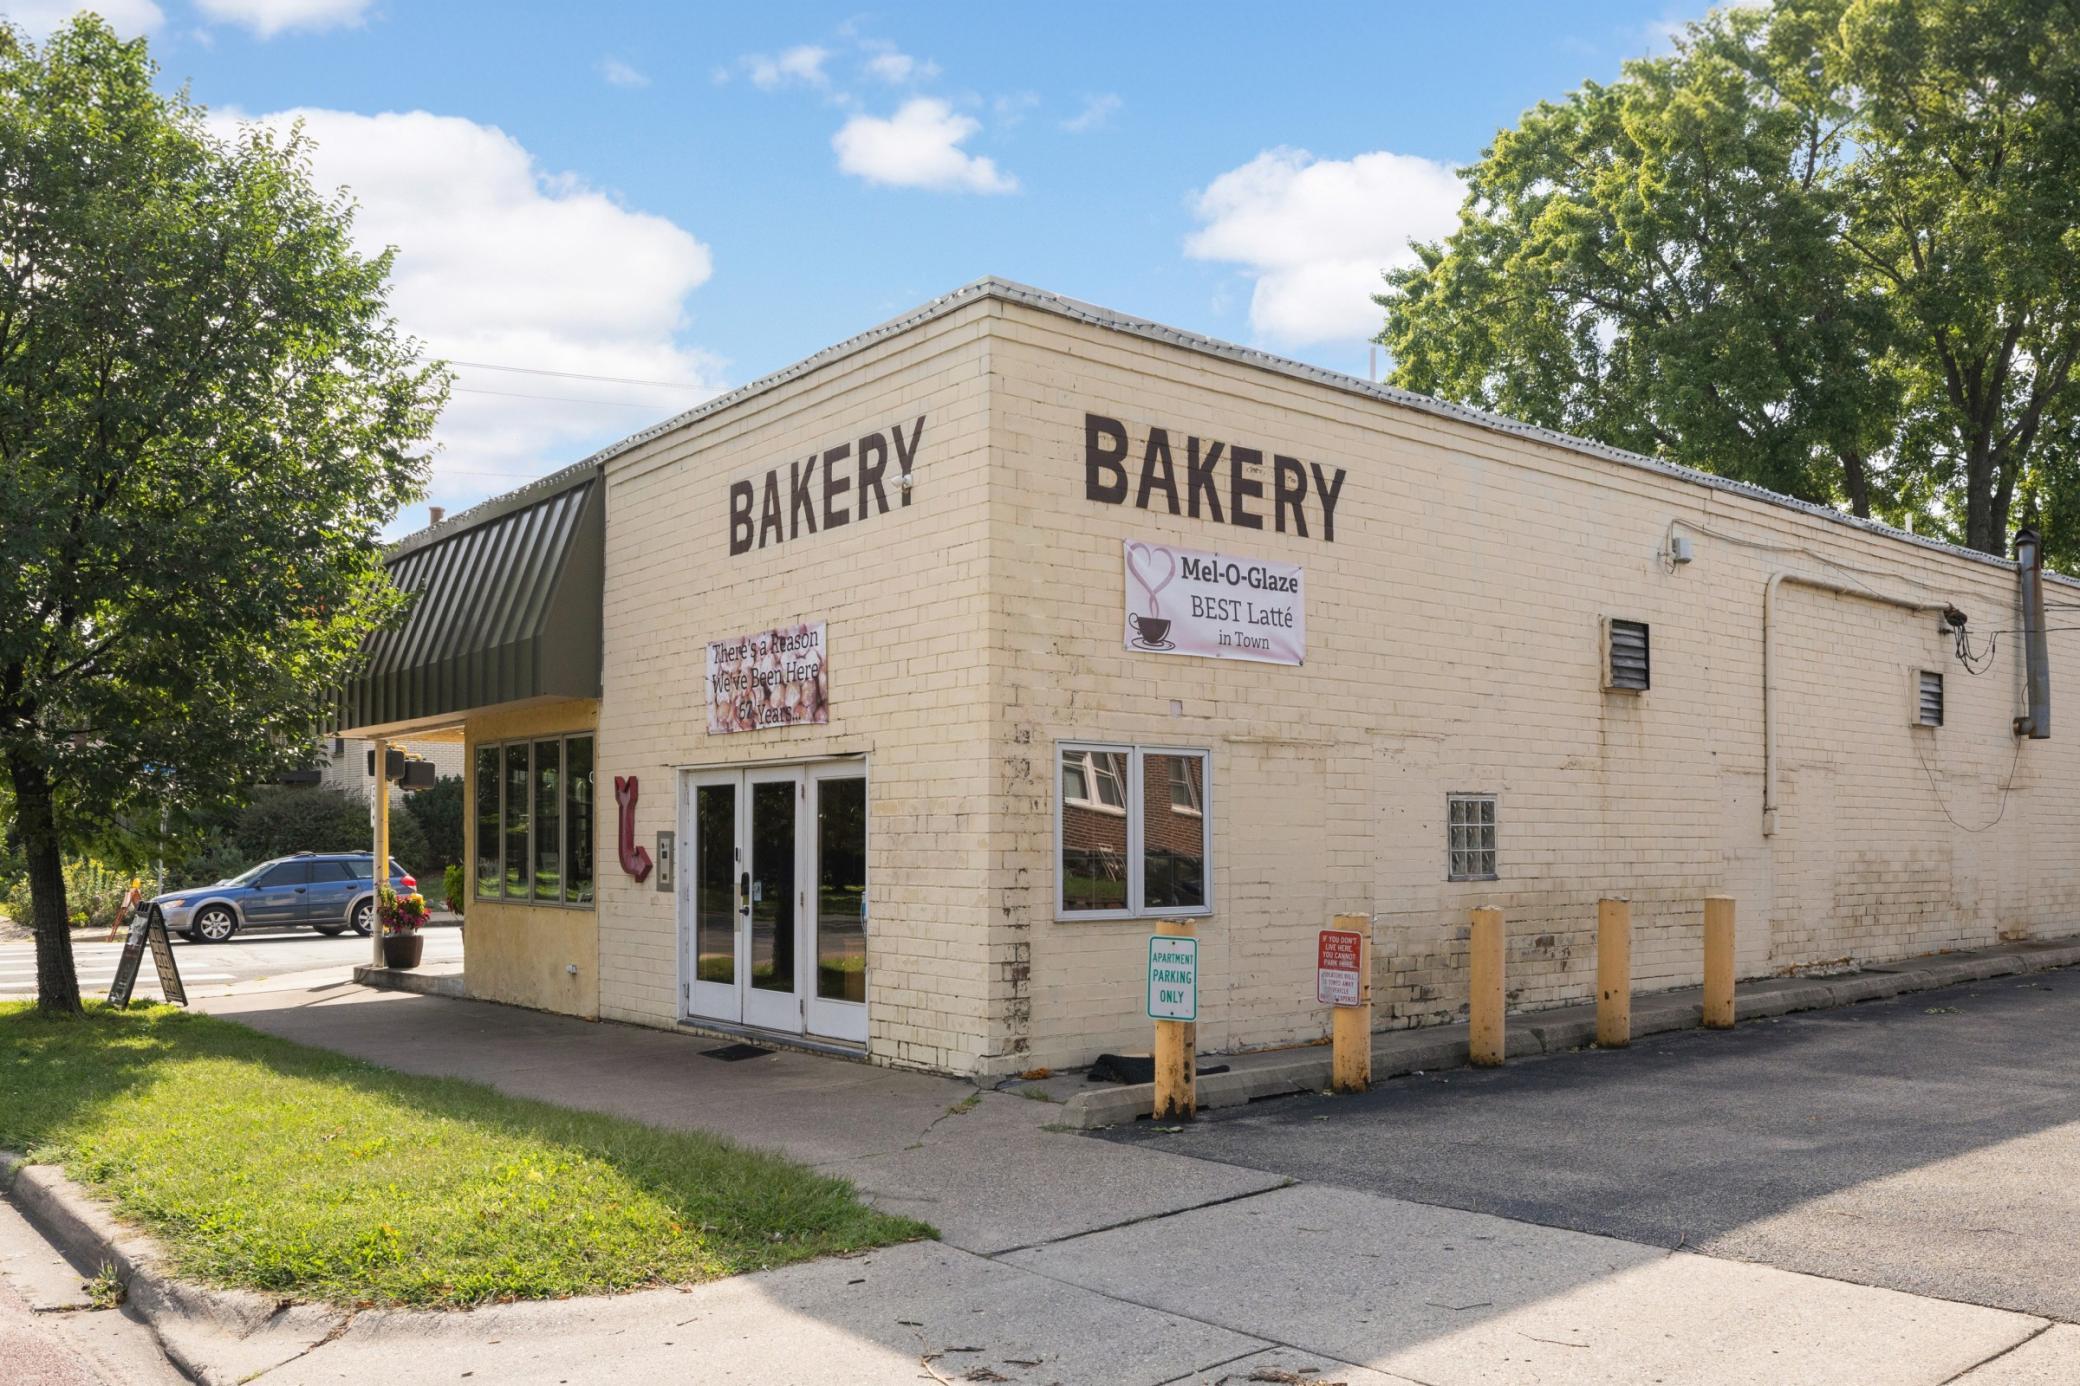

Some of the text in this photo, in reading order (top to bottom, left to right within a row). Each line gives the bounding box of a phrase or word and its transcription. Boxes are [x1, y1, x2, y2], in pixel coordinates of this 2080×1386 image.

[730, 415, 926, 556] BAKERY
[1085, 413, 1347, 542] BAKERY
[1181, 556, 1298, 593] Mel-O-Glaze
[1191, 595, 1293, 628] BEST Latté
[712, 631, 818, 664] There's a Reason
[1218, 629, 1270, 649] in Town
[712, 662, 819, 693] We've Been Here
[757, 705, 801, 725] Years...
[1152, 952, 1194, 965] APARTMENT
[1153, 969, 1192, 984] PARKING
[1160, 989, 1184, 1004] ONLY
